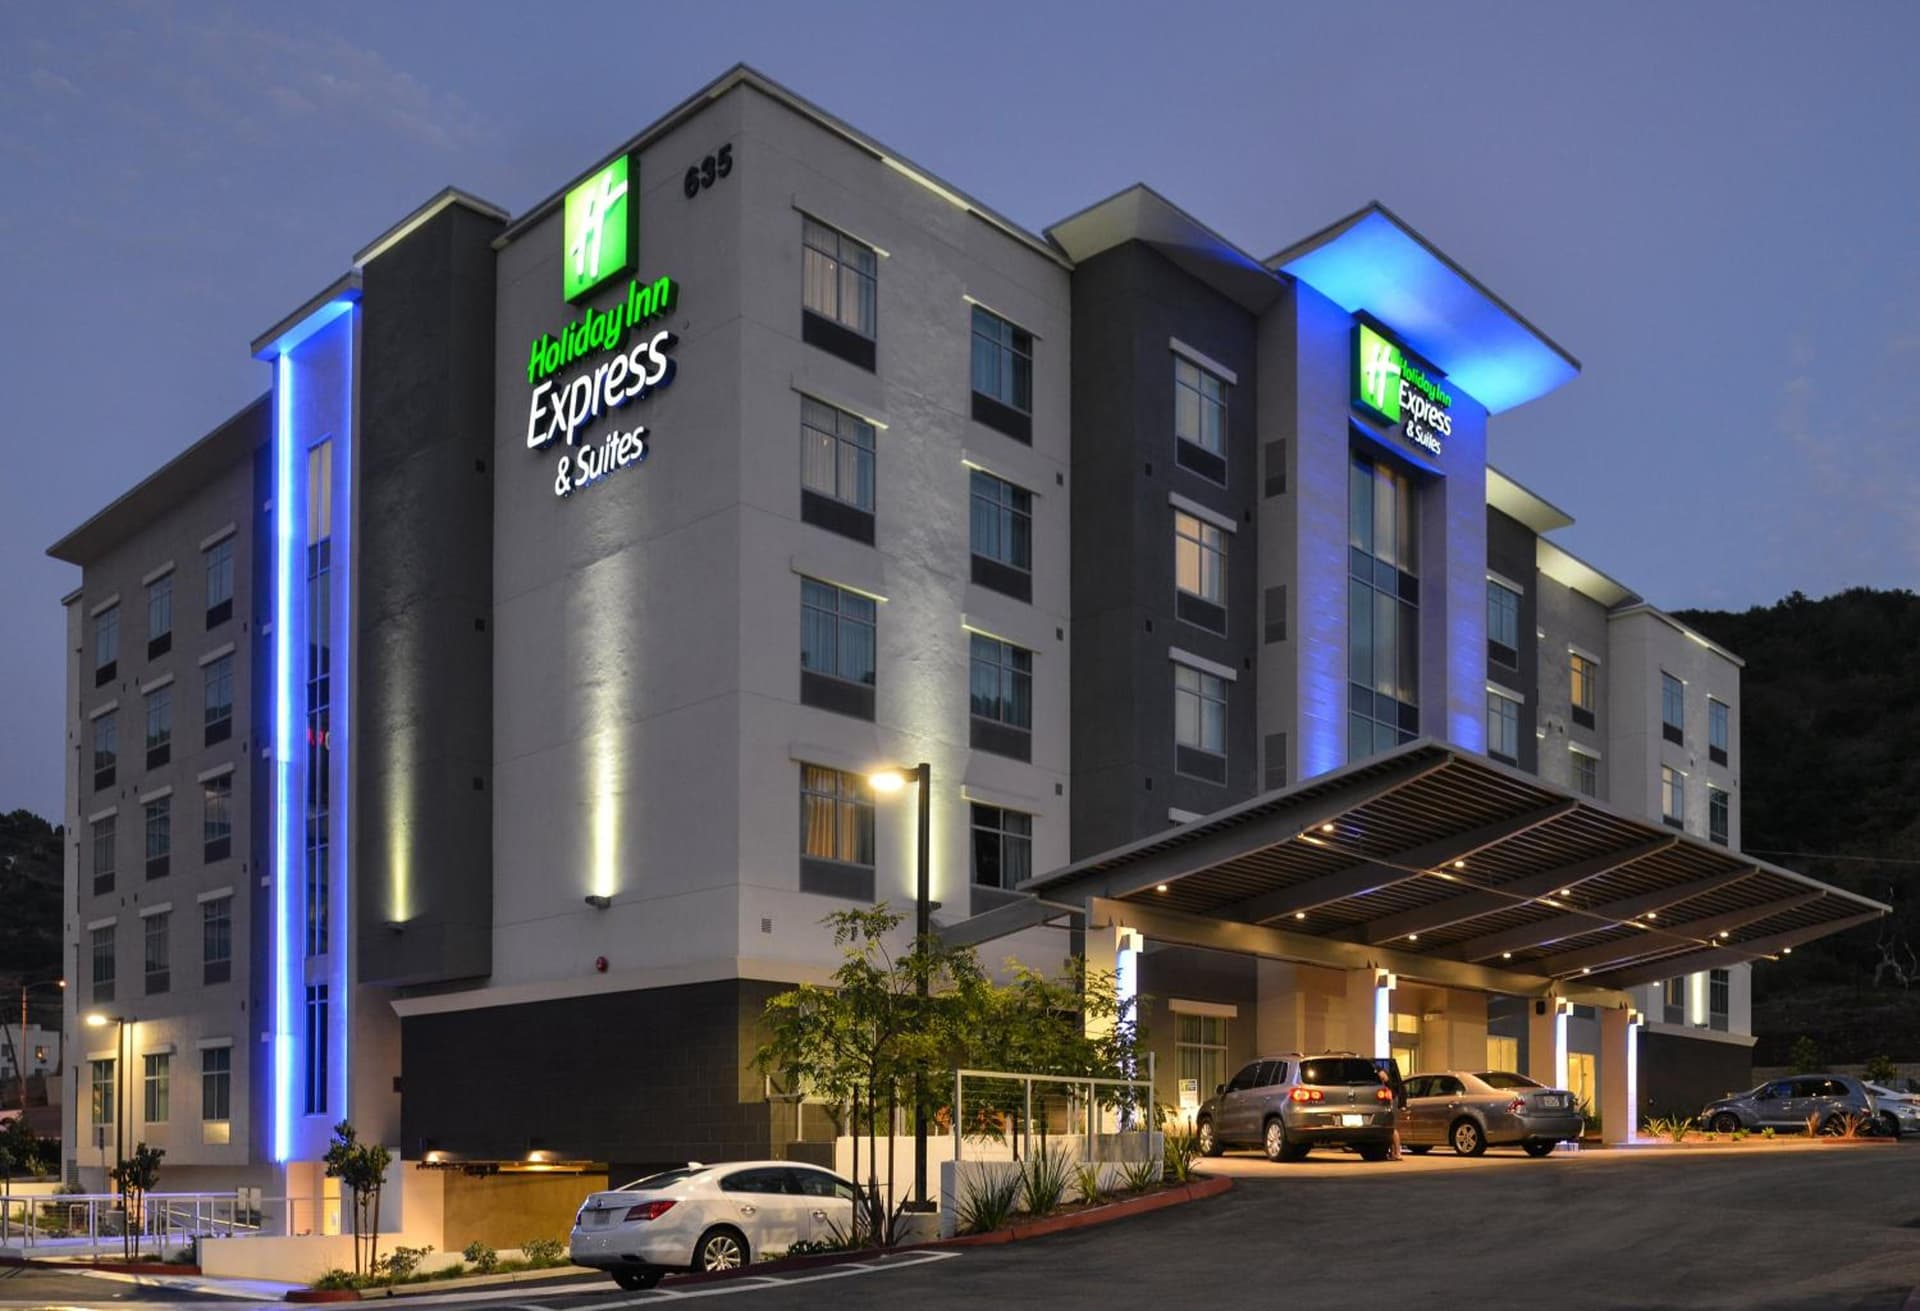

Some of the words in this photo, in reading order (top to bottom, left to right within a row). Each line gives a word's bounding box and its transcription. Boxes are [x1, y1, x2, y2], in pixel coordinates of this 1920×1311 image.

[684, 143, 733, 199] 635
[527, 303, 623, 384] Holiday
[626, 276, 670, 327] Inn
[527, 330, 669, 448] Express
[1399, 379, 1452, 436] Express
[1400, 357, 1436, 401] Holiday
[1436, 384, 1452, 408] Inn
[555, 456, 572, 496] &
[575, 426, 644, 486] Suites
[1406, 420, 1414, 438] &
[1415, 425, 1441, 455] Suites
